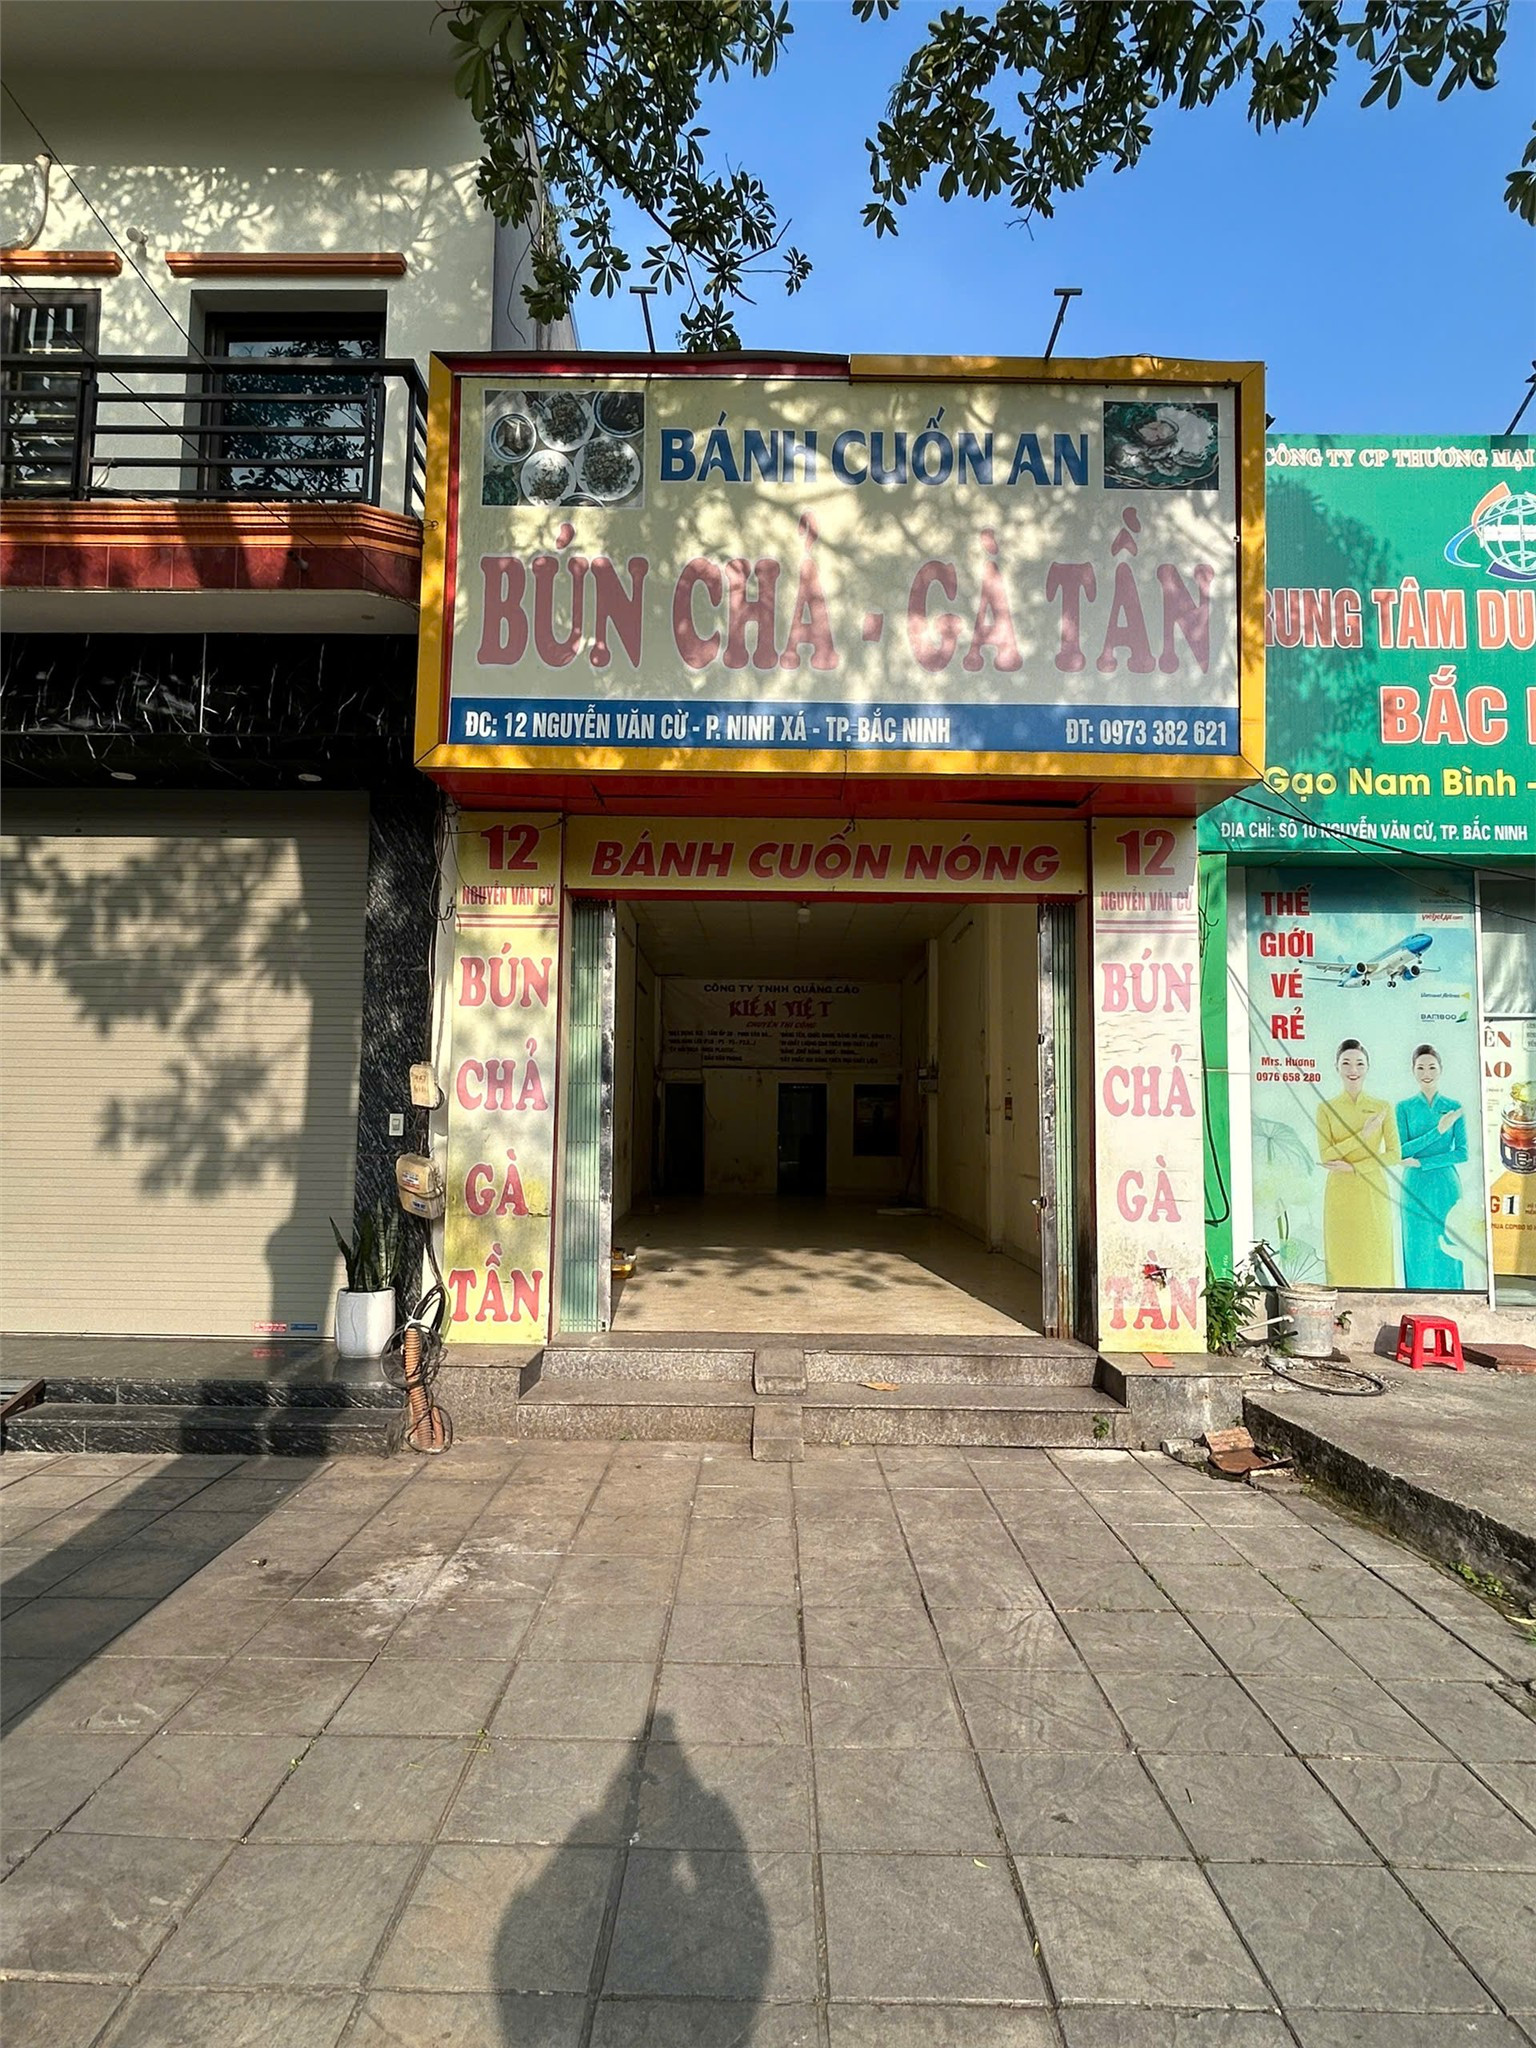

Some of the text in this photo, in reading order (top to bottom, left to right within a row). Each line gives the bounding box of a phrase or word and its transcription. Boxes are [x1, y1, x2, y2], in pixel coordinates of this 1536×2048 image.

[660, 406, 1088, 485] BÁNH CUỐN AN
[1265, 443, 1535, 472] CÔNG TY CP THƯƠNG MẠI
[476, 523, 649, 669] BÚN
[672, 511, 838, 670] CHẢ
[907, 527, 1023, 672] GÀ
[1046, 506, 1214, 674] TẦN
[1371, 576, 1467, 649] TÂM
[1476, 589, 1536, 650] DU
[465, 711, 497, 737] ĐC:
[504, 712, 527, 737] 12
[532, 703, 610, 739] NGUYỄN
[616, 708, 654, 739] VĂN
[660, 708, 689, 740] CỪ
[706, 715, 720, 740] P.
[727, 715, 774, 740] NINH
[780, 711, 807, 740] XÁ
[826, 716, 851, 742] TP.
[857, 707, 896, 743] BẮC
[902, 718, 950, 743] NINH
[1380, 665, 1508, 745] BẮC
[1066, 718, 1227, 746] ĐT: 0973 382 621
[1264, 766, 1337, 803] Gạo
[1349, 767, 1431, 796] Nam
[1442, 765, 1516, 797] Bình
[481, 824, 540, 872] 12
[590, 821, 1060, 882] BÁNH CUỐN NÓNG
[1116, 828, 1176, 877] 12
[1221, 822, 1245, 842] ĐỊA
[1302, 823, 1317, 838] 10
[1320, 815, 1377, 839] NGUYỄN
[1381, 820, 1410, 839] VĂN
[1440, 824, 1459, 840] TP.
[1463, 815, 1490, 840] BẮC
[1494, 825, 1528, 841] NINH
[1261, 884, 1312, 917] THẾ
[1260, 928, 1314, 957] GIỚI
[459, 942, 552, 1008] BÚN
[703, 983, 736, 992] CÔNG
[740, 985, 754, 993] TY
[759, 985, 789, 993] TNHH
[1101, 948, 1193, 1013] BÚN
[1271, 968, 1304, 998] VÉ
[1272, 1006, 1306, 1040] RẺ
[456, 1037, 548, 1111] CHẢ
[1102, 1044, 1196, 1117] CHẢ
[1256, 1072, 1321, 1082] 0976 658 280
[1261, 1056, 1282, 1066] Mrs.
[464, 1149, 529, 1216] GÀ
[1116, 1155, 1182, 1223] GÀ
[449, 1243, 543, 1322] TẦN
